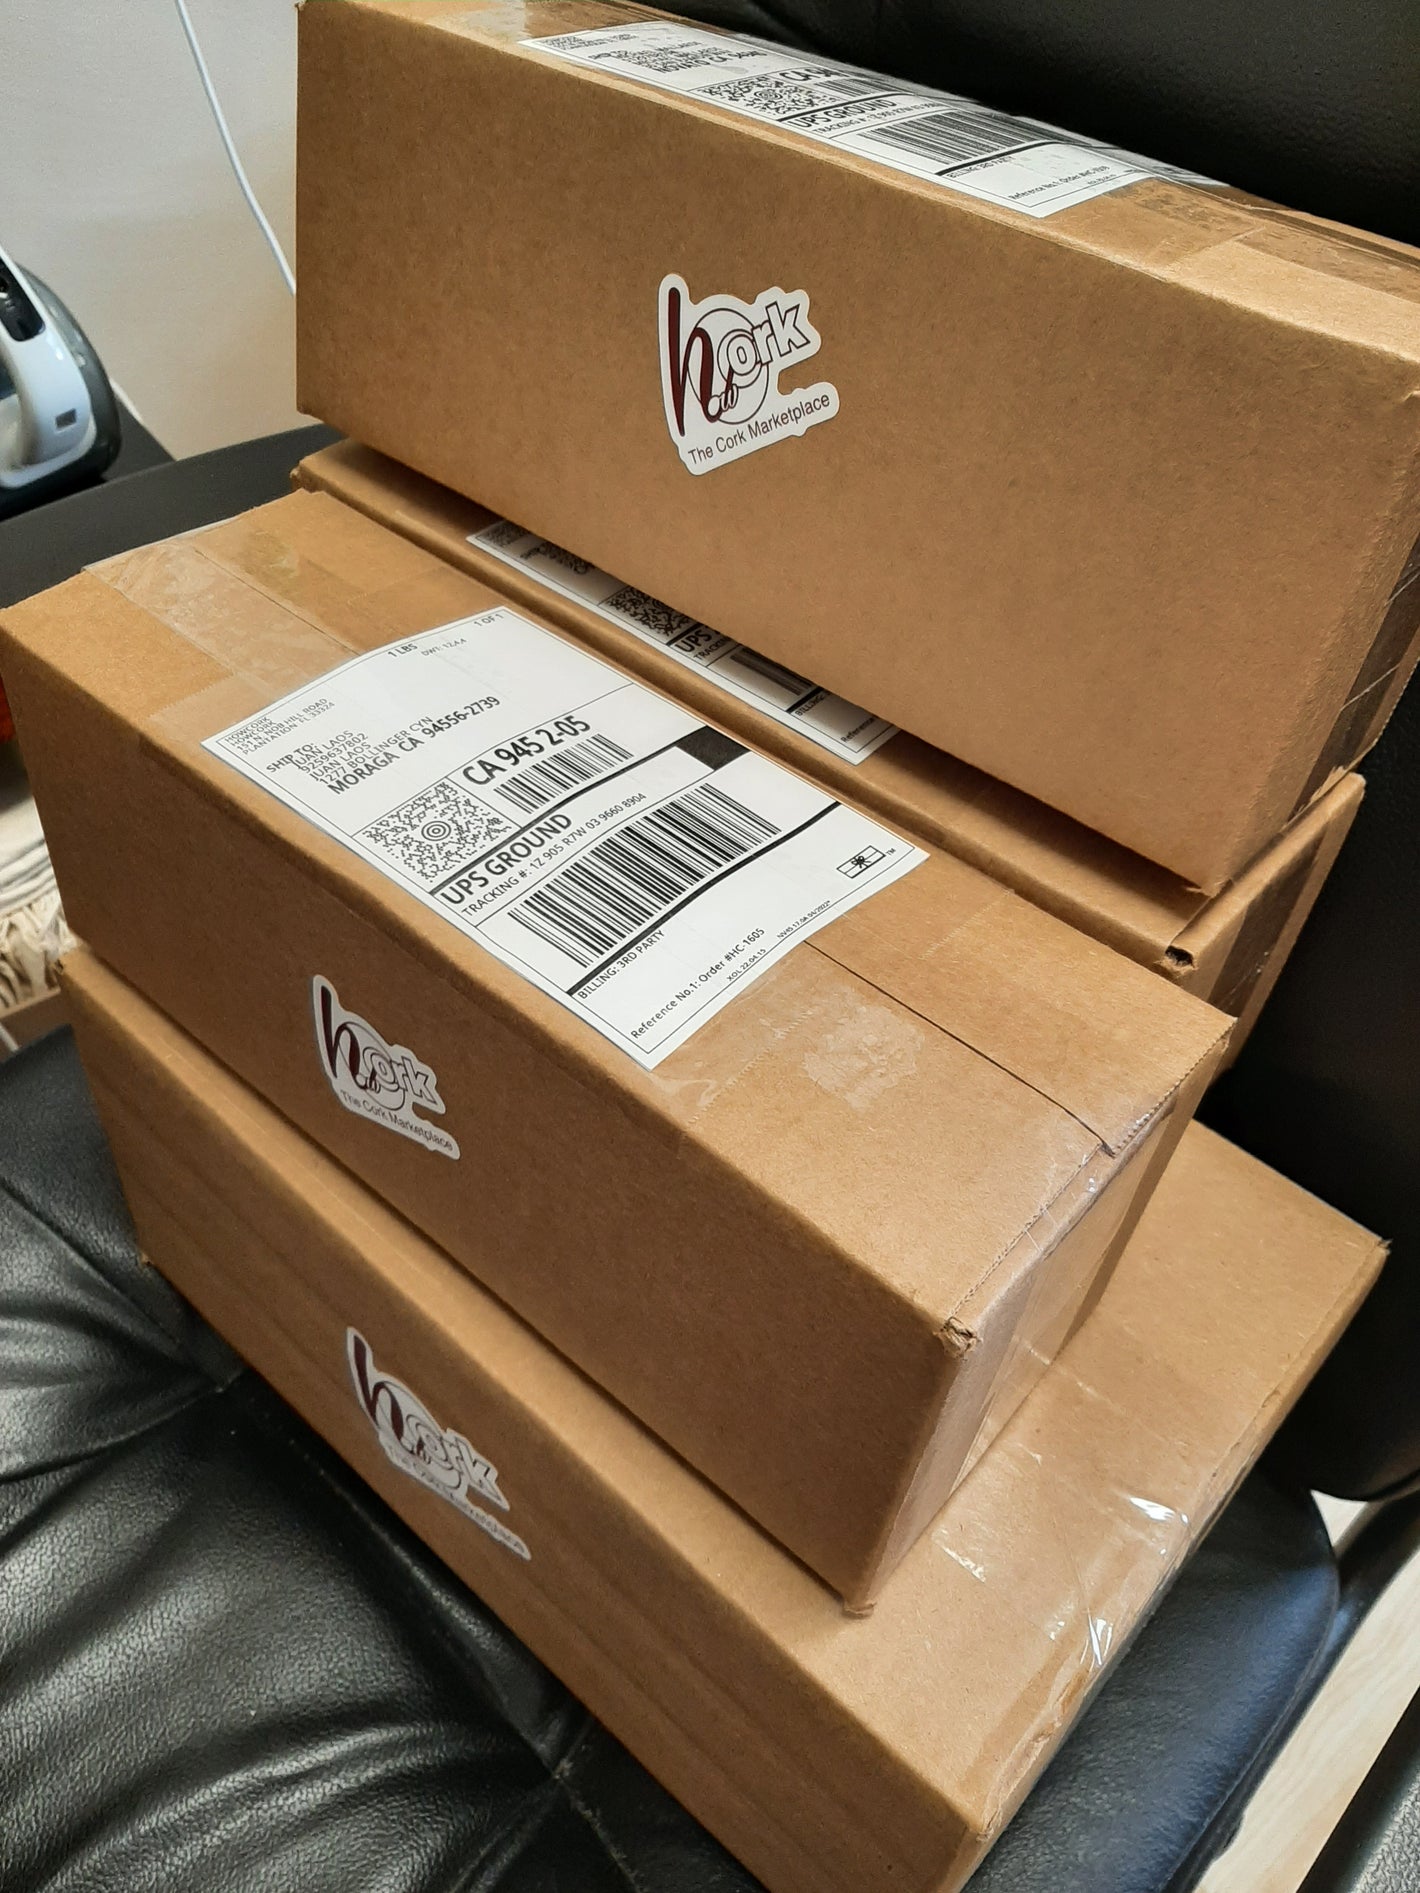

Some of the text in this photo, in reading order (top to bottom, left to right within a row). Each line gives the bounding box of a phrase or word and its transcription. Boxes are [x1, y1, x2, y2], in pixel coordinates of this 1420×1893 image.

[787, 100, 897, 128] UPS GROUND
[688, 394, 830, 465] The Cork Marketplace
[387, 643, 418, 658] 1 LBS
[675, 628, 713, 653] UPS
[224, 717, 271, 743] HOWCORK
[230, 720, 277, 747] HOWCORK
[237, 740, 253, 751] 151
[264, 722, 285, 736] NOB
[283, 713, 304, 725] HILL
[302, 698, 328, 713] ROAD
[243, 702, 336, 755] PLANTATION FL 33324
[266, 743, 315, 773] SHIP TO:
[290, 730, 354, 770] JUAN LAOS
[301, 732, 369, 773] 9259637802
[309, 741, 371, 781] JUAN LAOS
[320, 716, 433, 784] 1277 BOLLINGER CYN
[327, 696, 501, 795] MORAGA CA 94556-2739
[461, 714, 591, 786] CA 945 2-05
[440, 813, 572, 905] UPS GROUND
[461, 792, 648, 917] TRACKING #: 1Z 905 R7W 03 9660 8904
[577, 929, 665, 1000] BILLING: 3RD PARTY
[630, 927, 765, 1039] Reference No.1: Order #HC-1605
[726, 969, 743, 982] XOL
[363, 1100, 389, 1122] Cork
